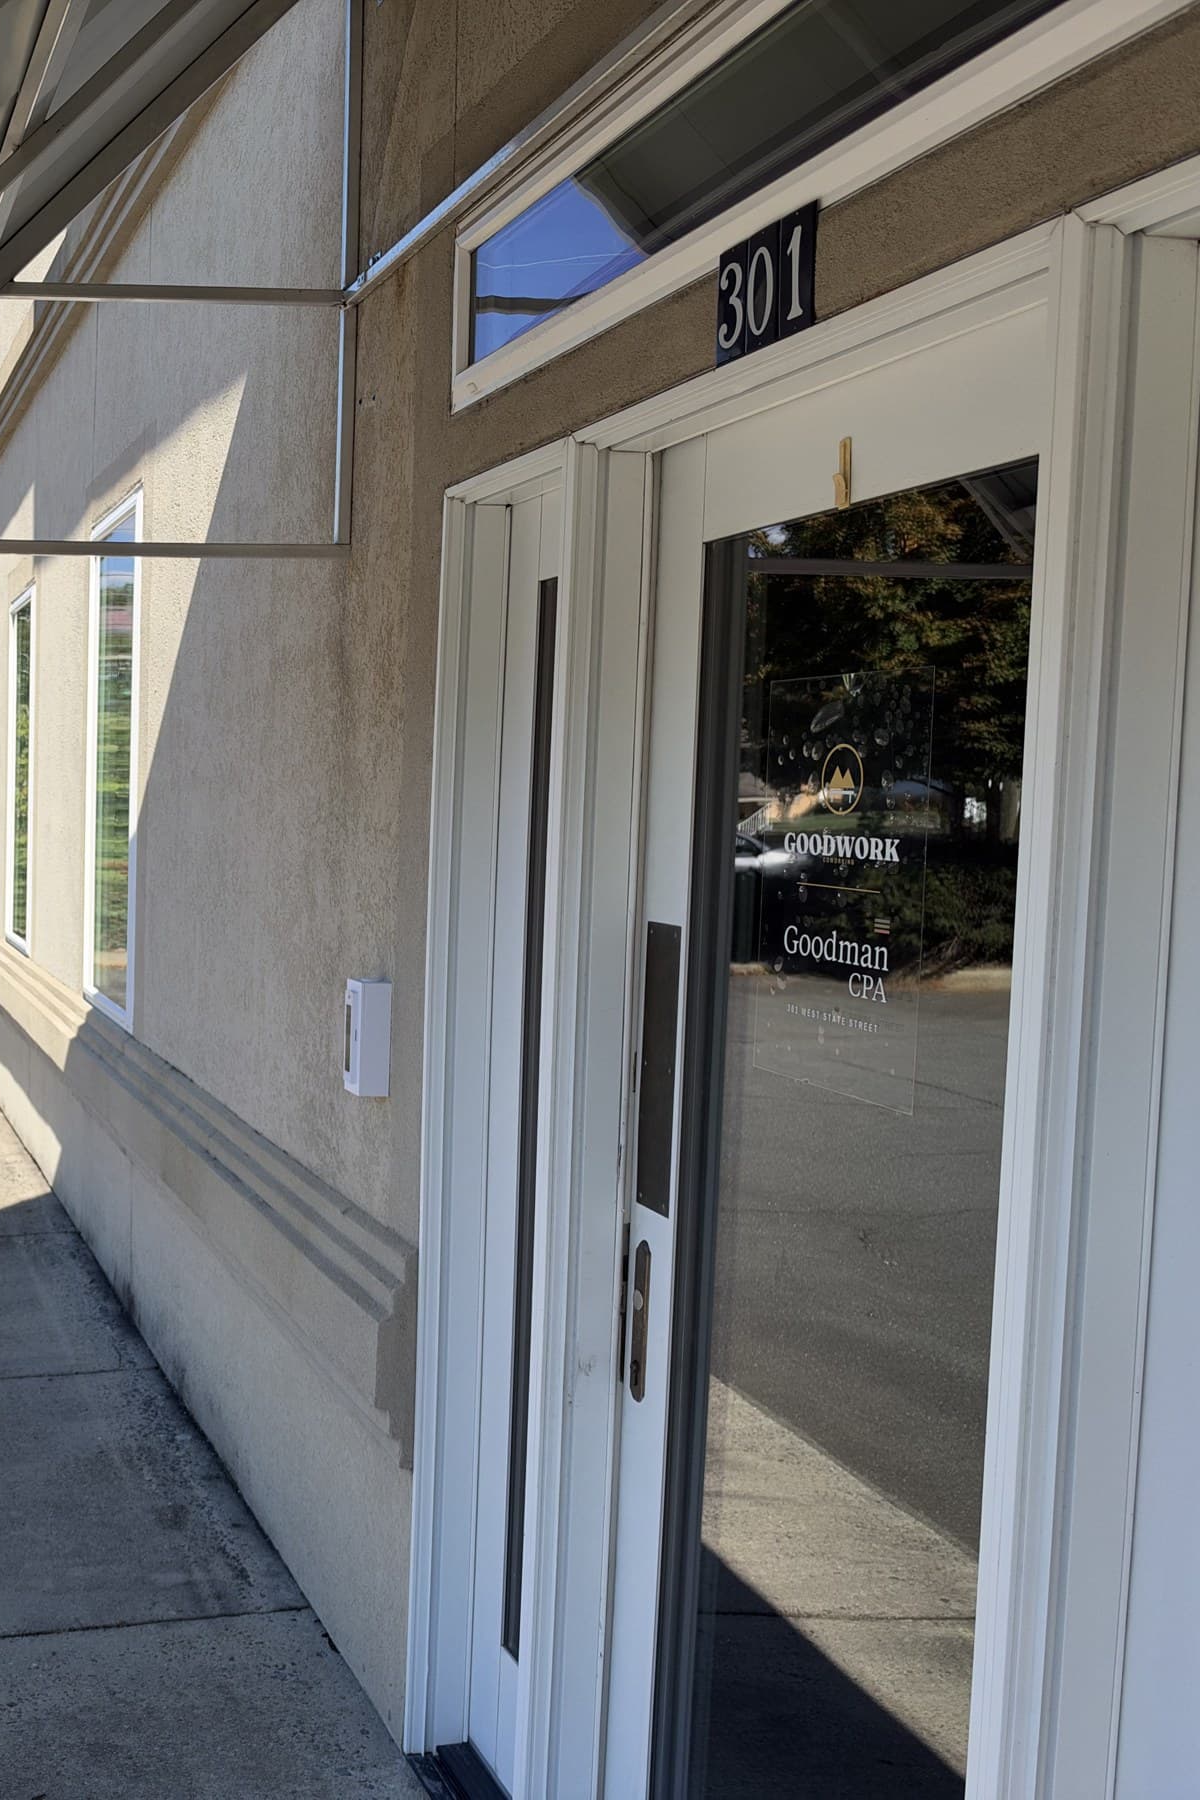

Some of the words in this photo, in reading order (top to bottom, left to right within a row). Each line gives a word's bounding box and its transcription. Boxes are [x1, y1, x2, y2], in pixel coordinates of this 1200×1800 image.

[718, 225, 803, 349] 301
[784, 832, 900, 862] GOODWORK
[783, 925, 889, 972] Goodman
[848, 972, 888, 1003] CPA
[801, 1007, 821, 1020] WEST
[823, 1012, 847, 1027] STATE
[849, 1018, 879, 1034] STREET
